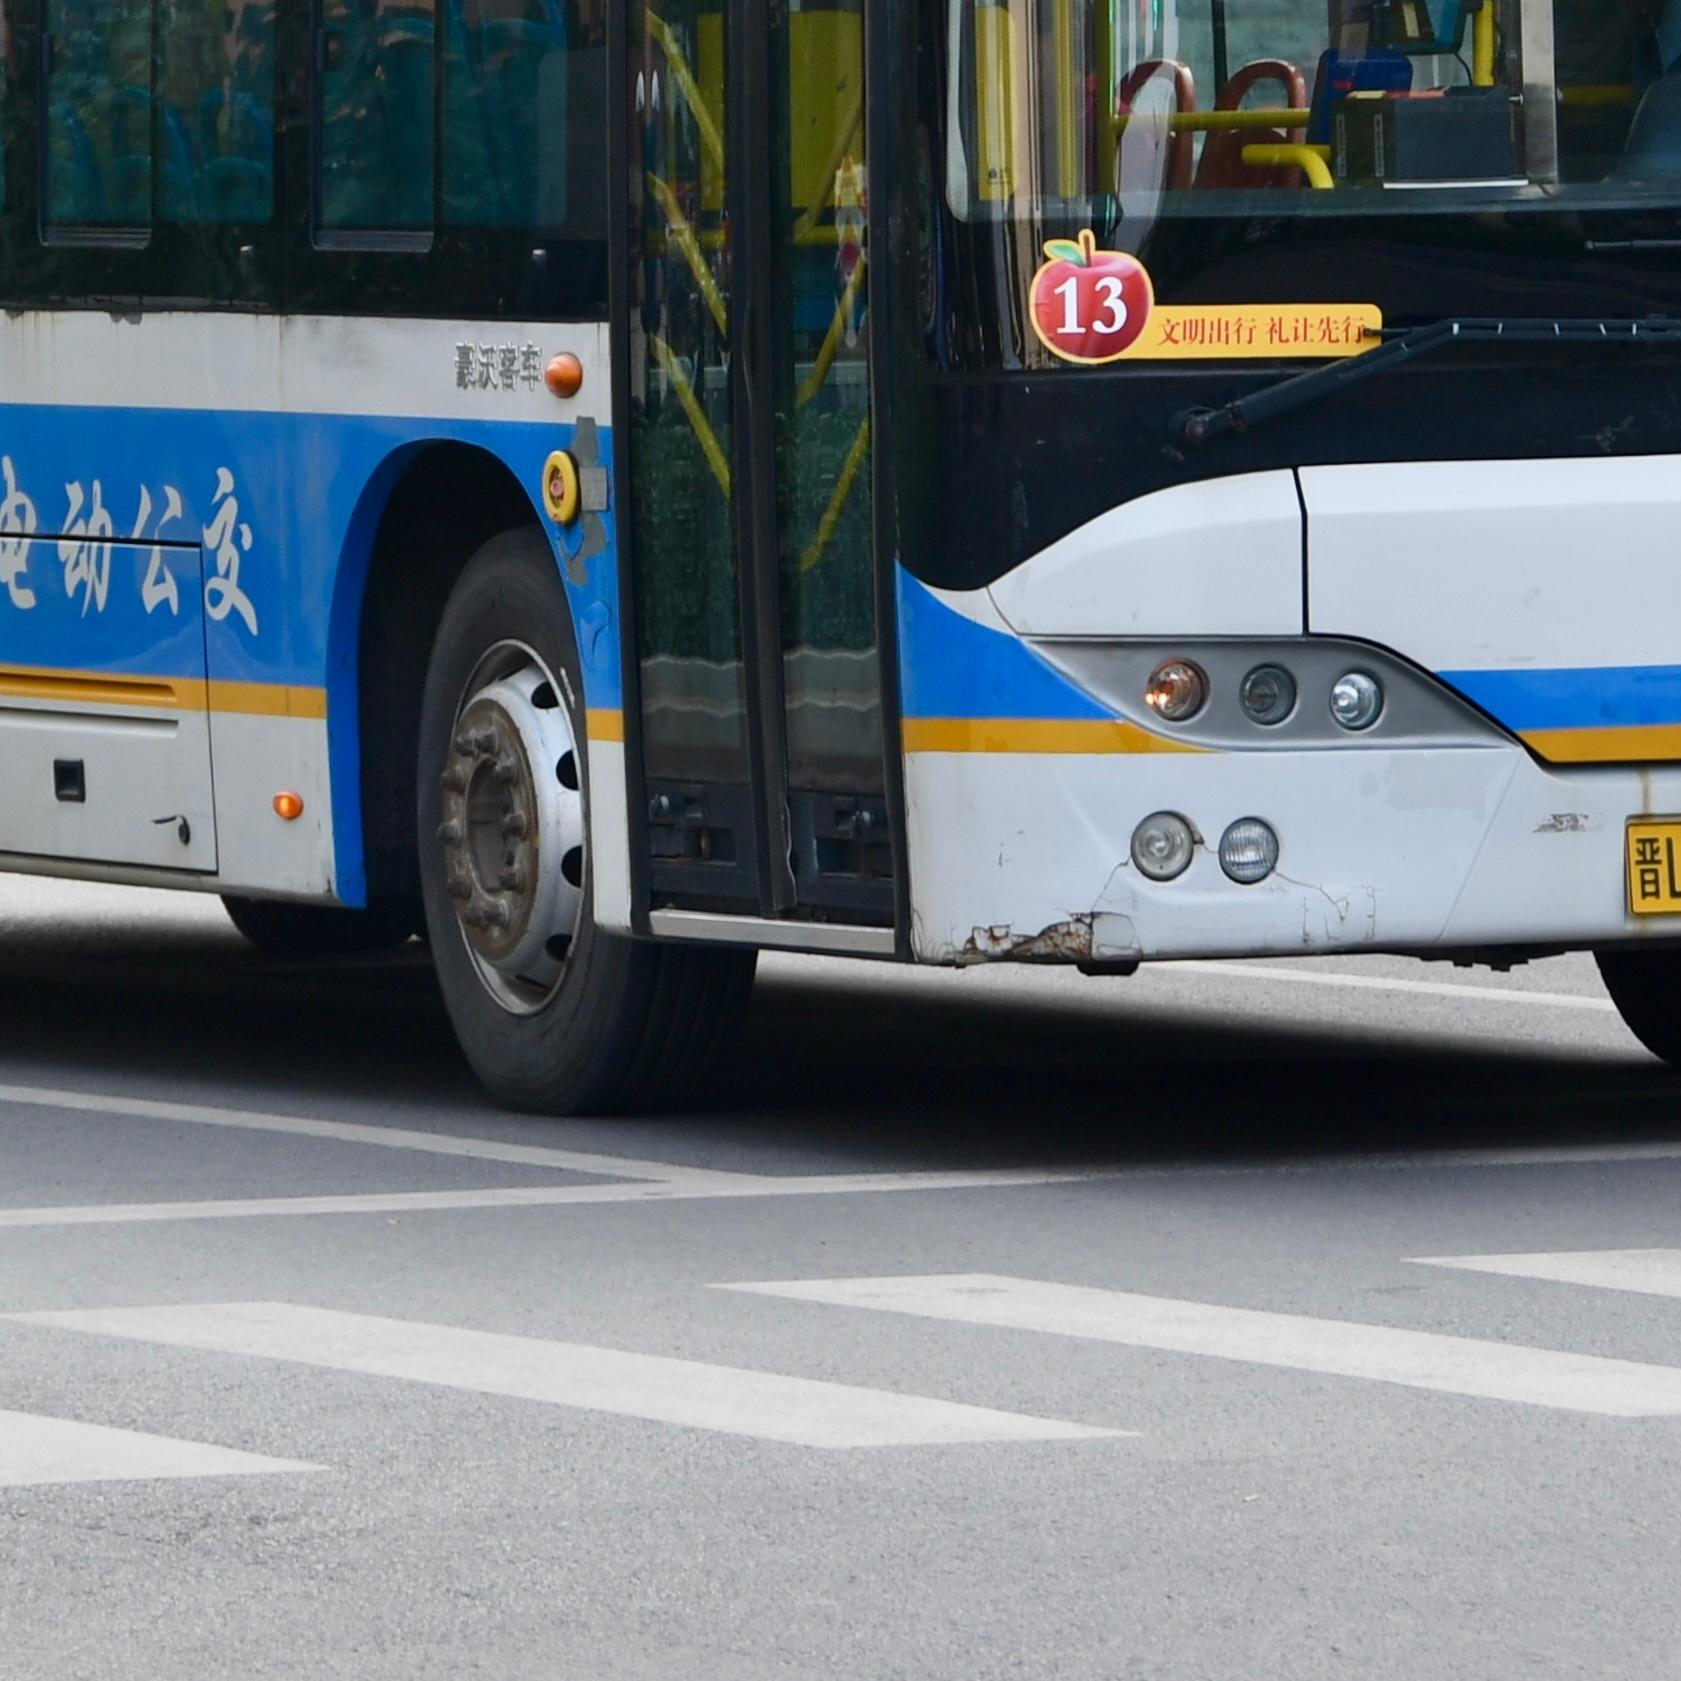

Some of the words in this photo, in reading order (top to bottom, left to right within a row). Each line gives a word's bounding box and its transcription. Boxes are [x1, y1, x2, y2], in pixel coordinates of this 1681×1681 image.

[1054, 276, 1128, 334] 13
[1157, 318, 1257, 346] 文明出行
[1267, 316, 1366, 346] 礼让先行
[454, 340, 543, 392] 豪沃客车
